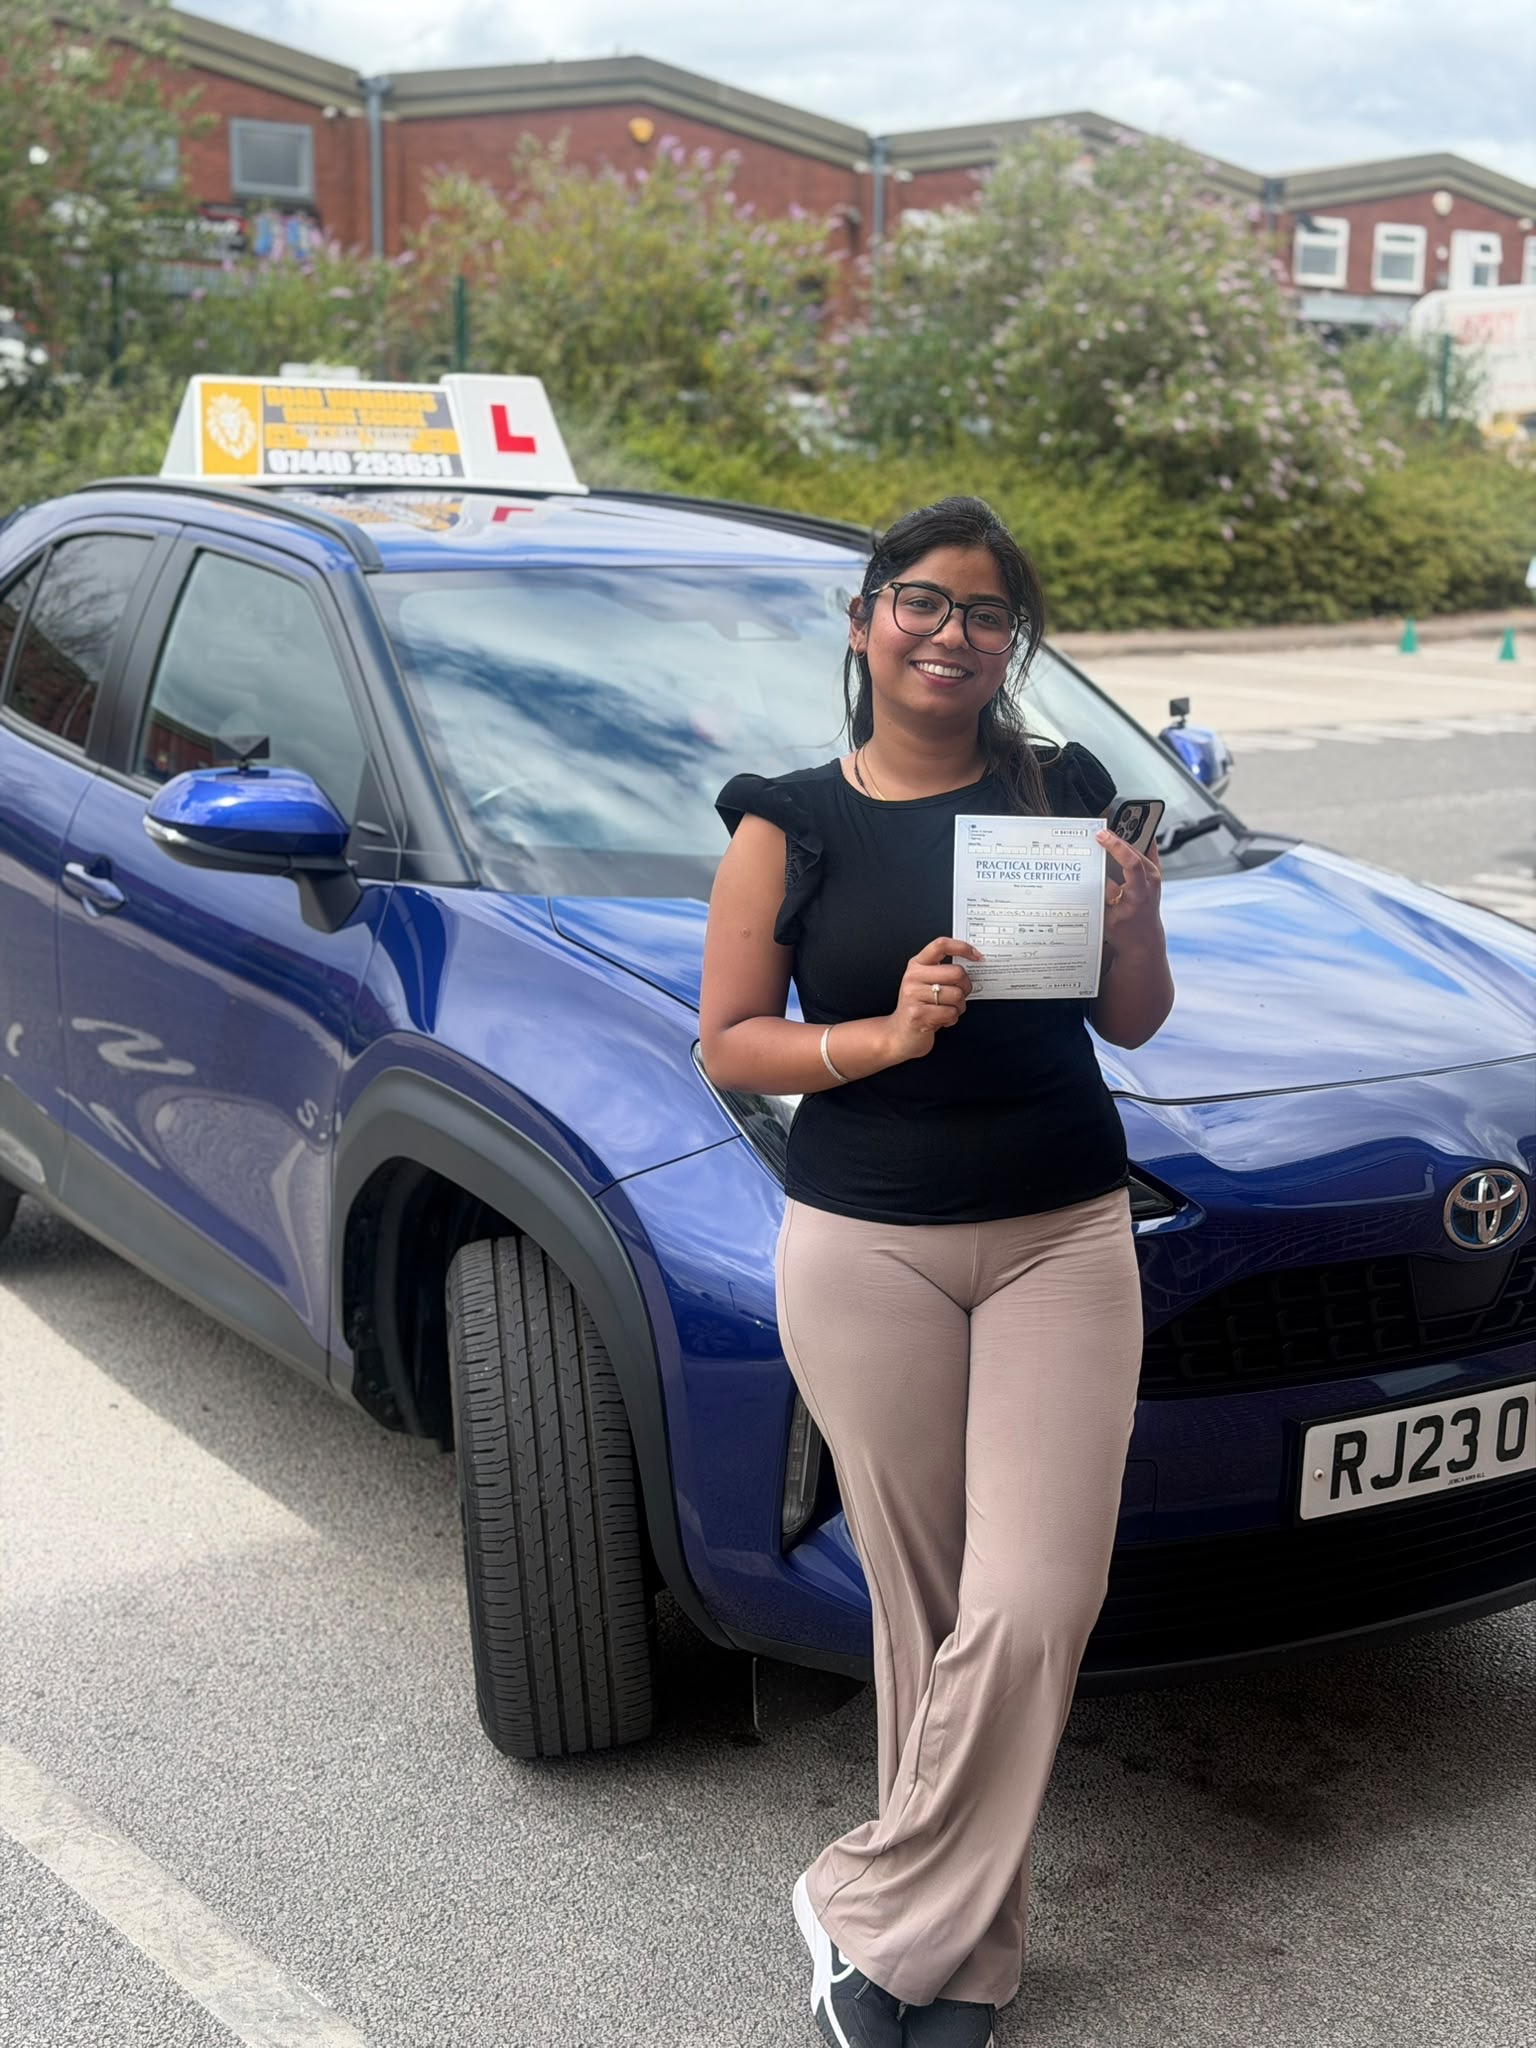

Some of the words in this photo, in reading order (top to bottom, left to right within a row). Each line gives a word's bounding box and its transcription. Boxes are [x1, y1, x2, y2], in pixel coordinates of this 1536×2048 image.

[491, 404, 536, 453] L
[976, 860, 1032, 871] PRACTICAL
[1035, 861, 1081, 872] DRIVING
[976, 871, 997, 879] TEST
[1000, 871, 1021, 880] PASS
[1024, 872, 1081, 881] CERTIFICATE
[1330, 1407, 1481, 1500] RJ23
